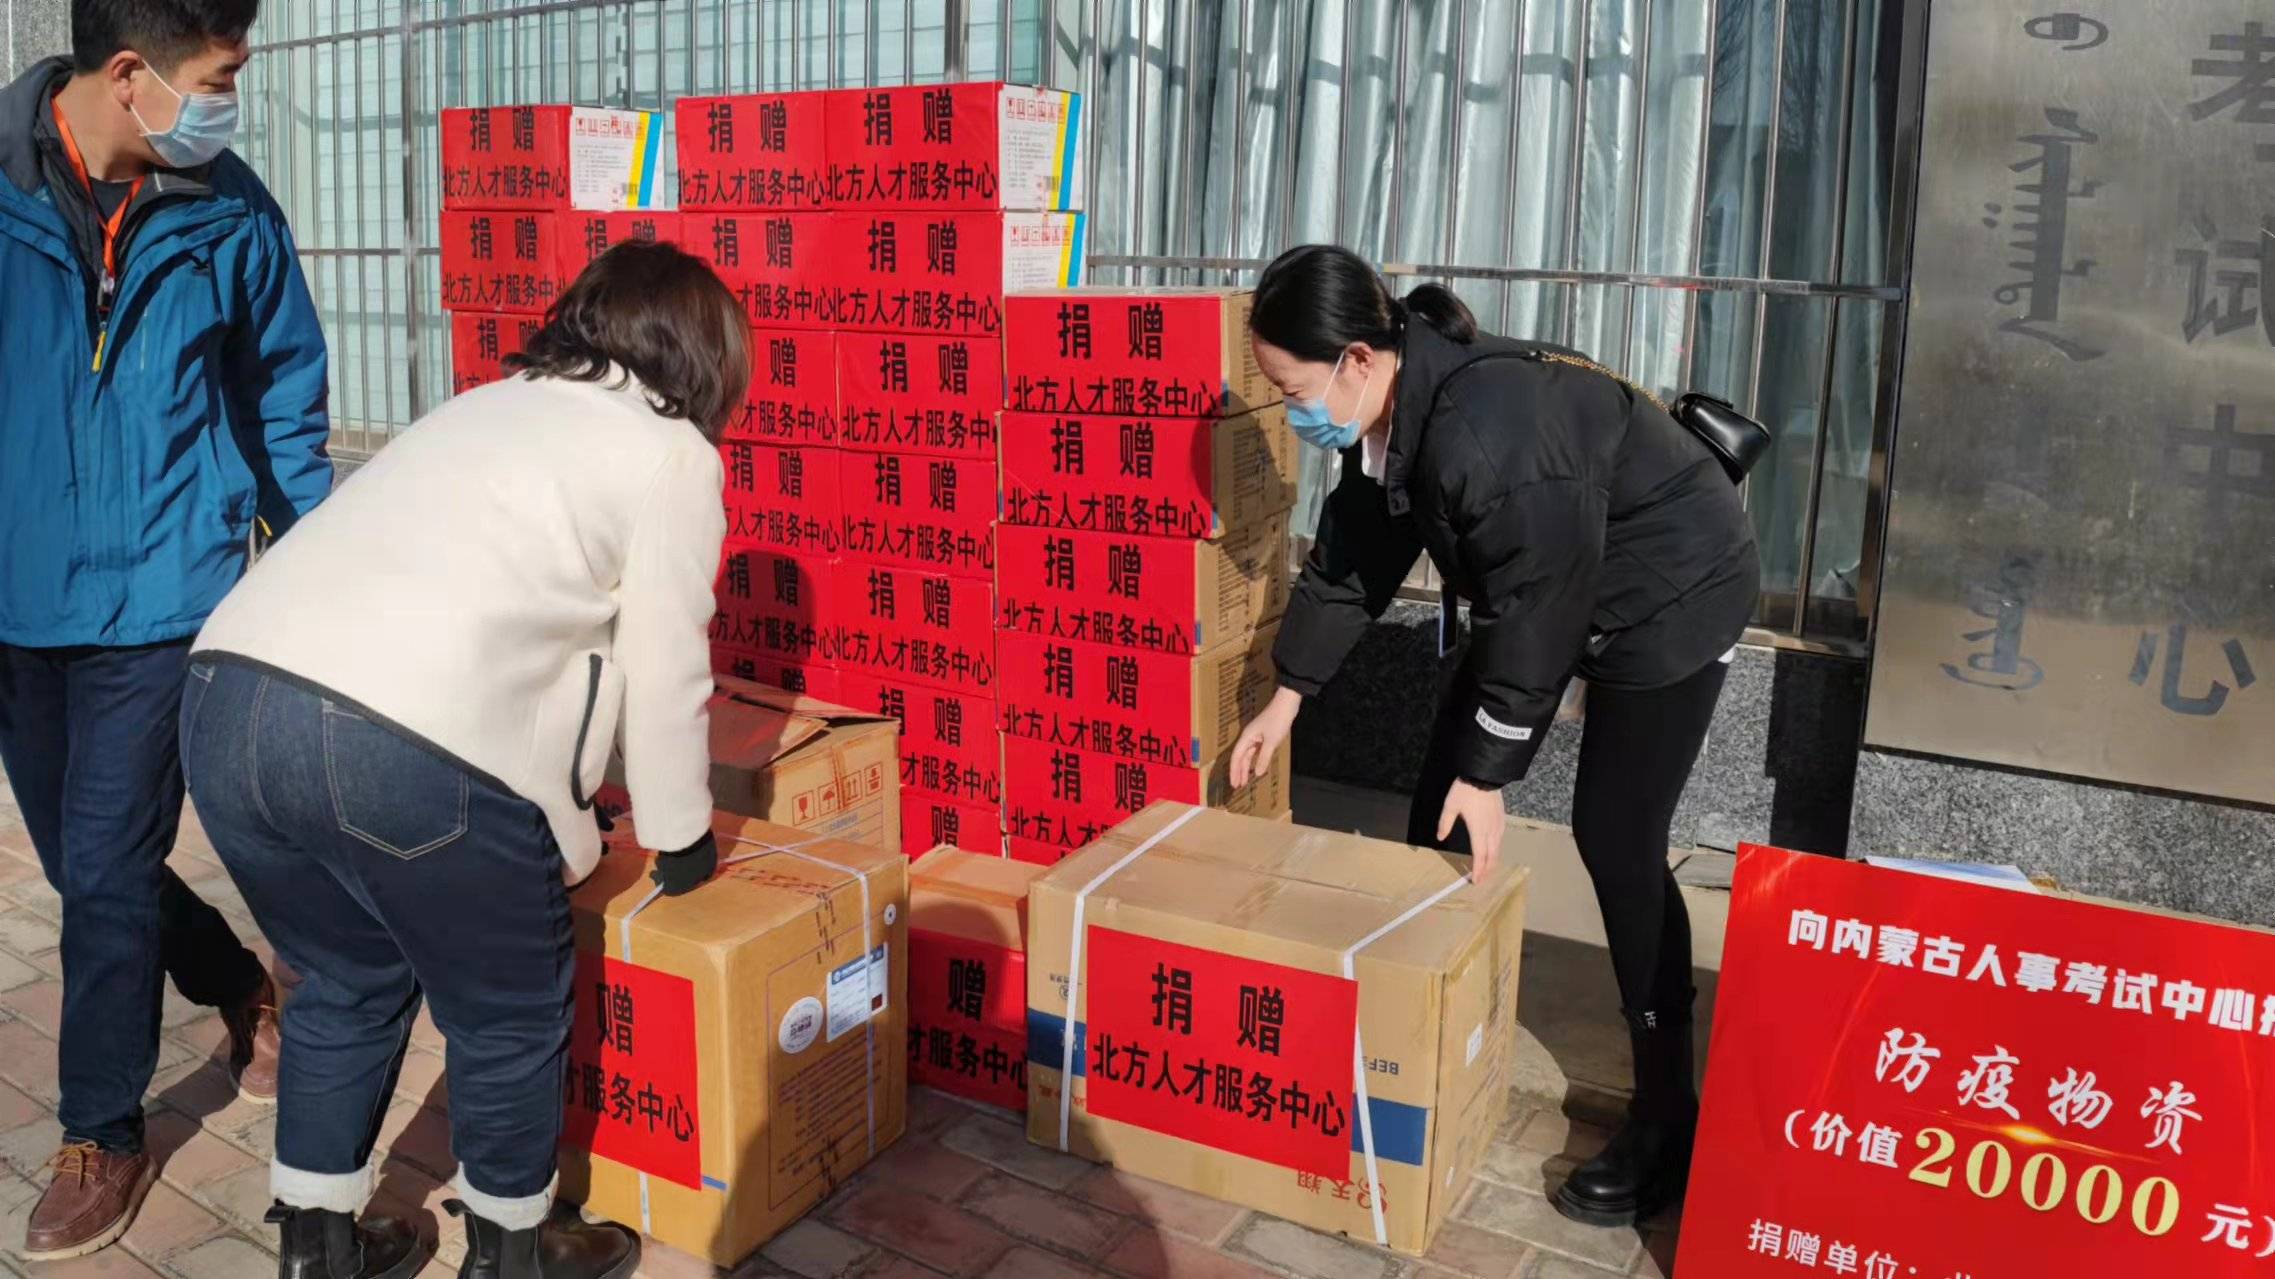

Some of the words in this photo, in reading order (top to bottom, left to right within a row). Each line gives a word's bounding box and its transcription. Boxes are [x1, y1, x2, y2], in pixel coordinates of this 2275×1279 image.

[443, 164, 567, 199] 北方人才服务中心
[678, 166, 826, 207] 北方人才服务中心
[826, 160, 998, 203] 北方人才服务中心
[831, 286, 1003, 333] 北方人才服务中心
[769, 337, 798, 389] 赠
[1012, 374, 1221, 418] 北方人才服务中心
[1007, 487, 1207, 540] 北方人才服务中心
[1003, 597, 1190, 655] 北方人才服务中心
[831, 625, 993, 687] 北方人才服务中心
[1002, 703, 1187, 769] 北方人才服务中心
[1010, 806, 1112, 849] 北方人才
[948, 958, 987, 1022] 赠
[595, 982, 634, 1057] 赠
[1092, 1033, 1346, 1137] 北方人才服务中心
[1874, 1026, 2204, 1155] 防疫物资
